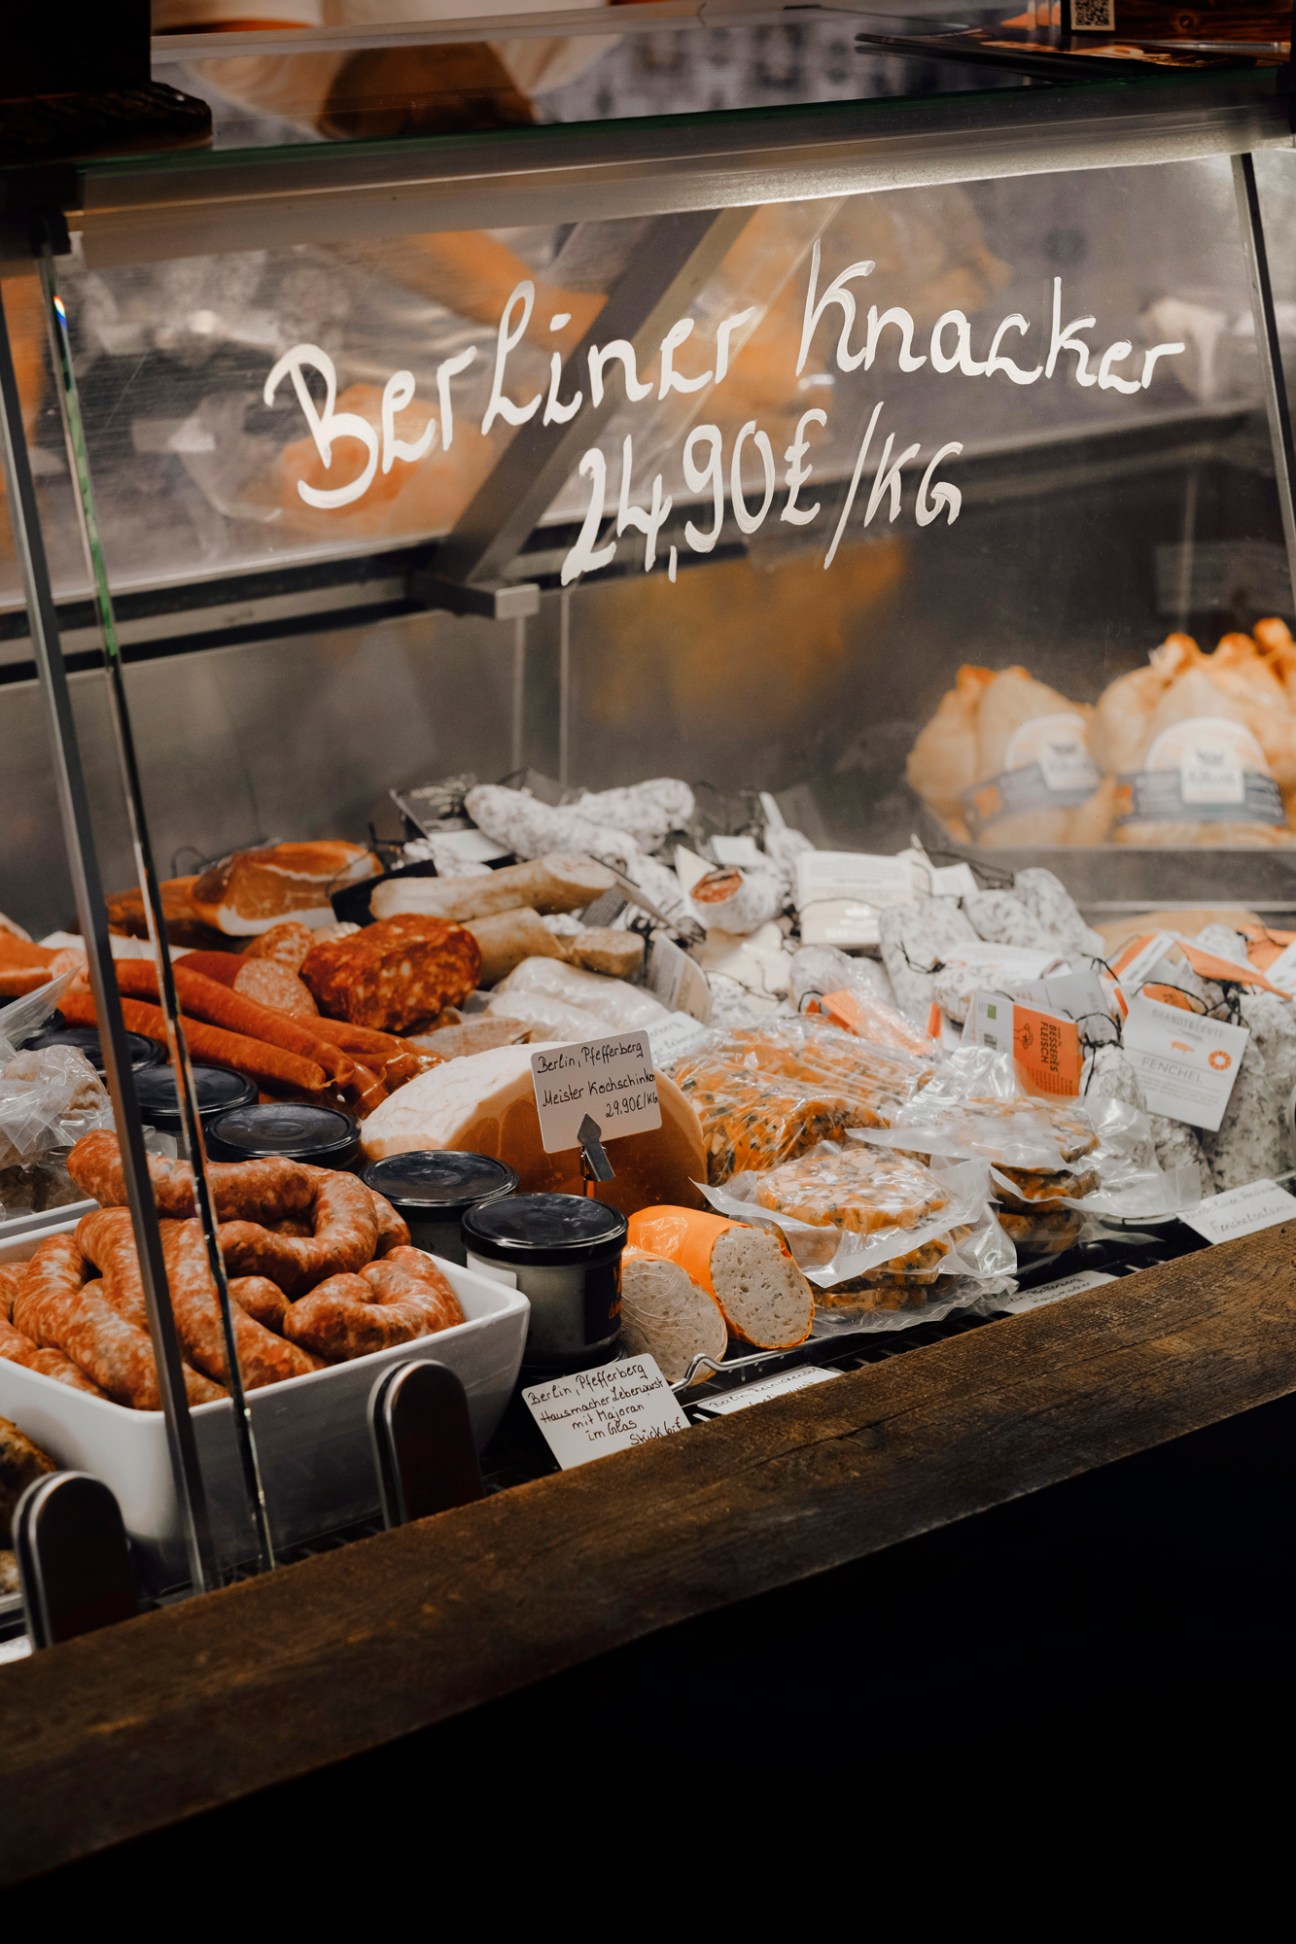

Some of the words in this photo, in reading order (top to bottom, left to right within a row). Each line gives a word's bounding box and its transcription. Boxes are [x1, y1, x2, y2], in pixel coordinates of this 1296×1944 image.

[264, 279, 766, 509] Berliner
[796, 242, 1185, 394] Knacker
[537, 1053, 581, 1074] Berlin,
[580, 1042, 644, 1066] Pfefferberg
[1040, 1021, 1049, 1064] FLEISCH
[1141, 1056, 1202, 1083] FENCHEL
[542, 1087, 584, 1107] Meister
[528, 1384, 581, 1406] Berlin,
[575, 1364, 649, 1392] Pfefferberg
[540, 1396, 610, 1423] Hausmacher
[610, 1377, 664, 1402] Leberwurst
[572, 1414, 593, 1430] mit
[596, 1403, 645, 1424] Majoran
[585, 1429, 606, 1442] im
[607, 1420, 637, 1436] Glas
